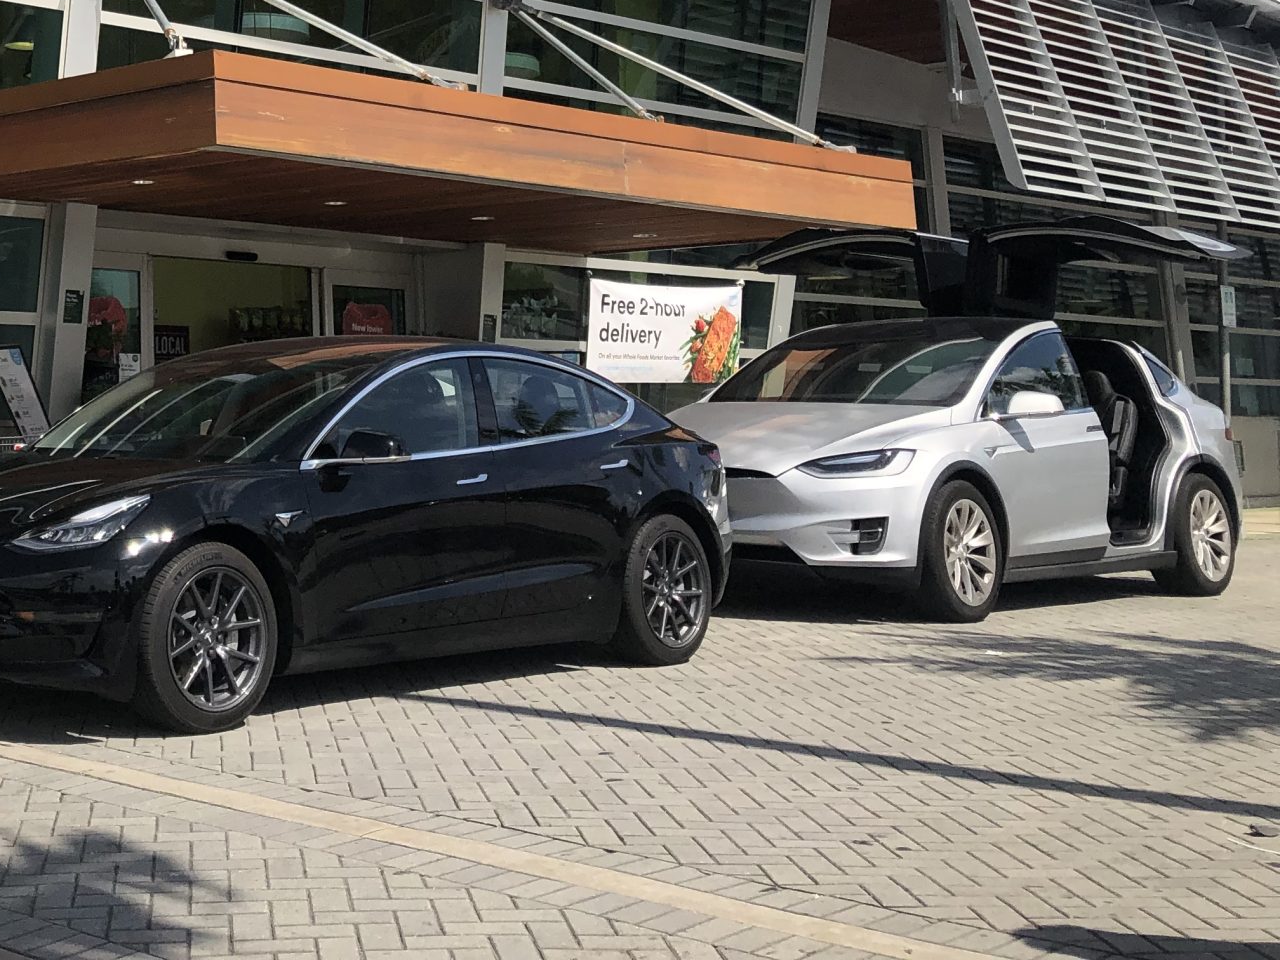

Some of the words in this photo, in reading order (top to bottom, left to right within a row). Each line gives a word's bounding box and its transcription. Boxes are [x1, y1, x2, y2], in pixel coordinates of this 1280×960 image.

[600, 293, 636, 315] Free
[639, 297, 686, 318] 2-hour
[351, 322, 366, 332] New
[599, 322, 662, 349] delivery
[154, 336, 186, 354] LOCAL
